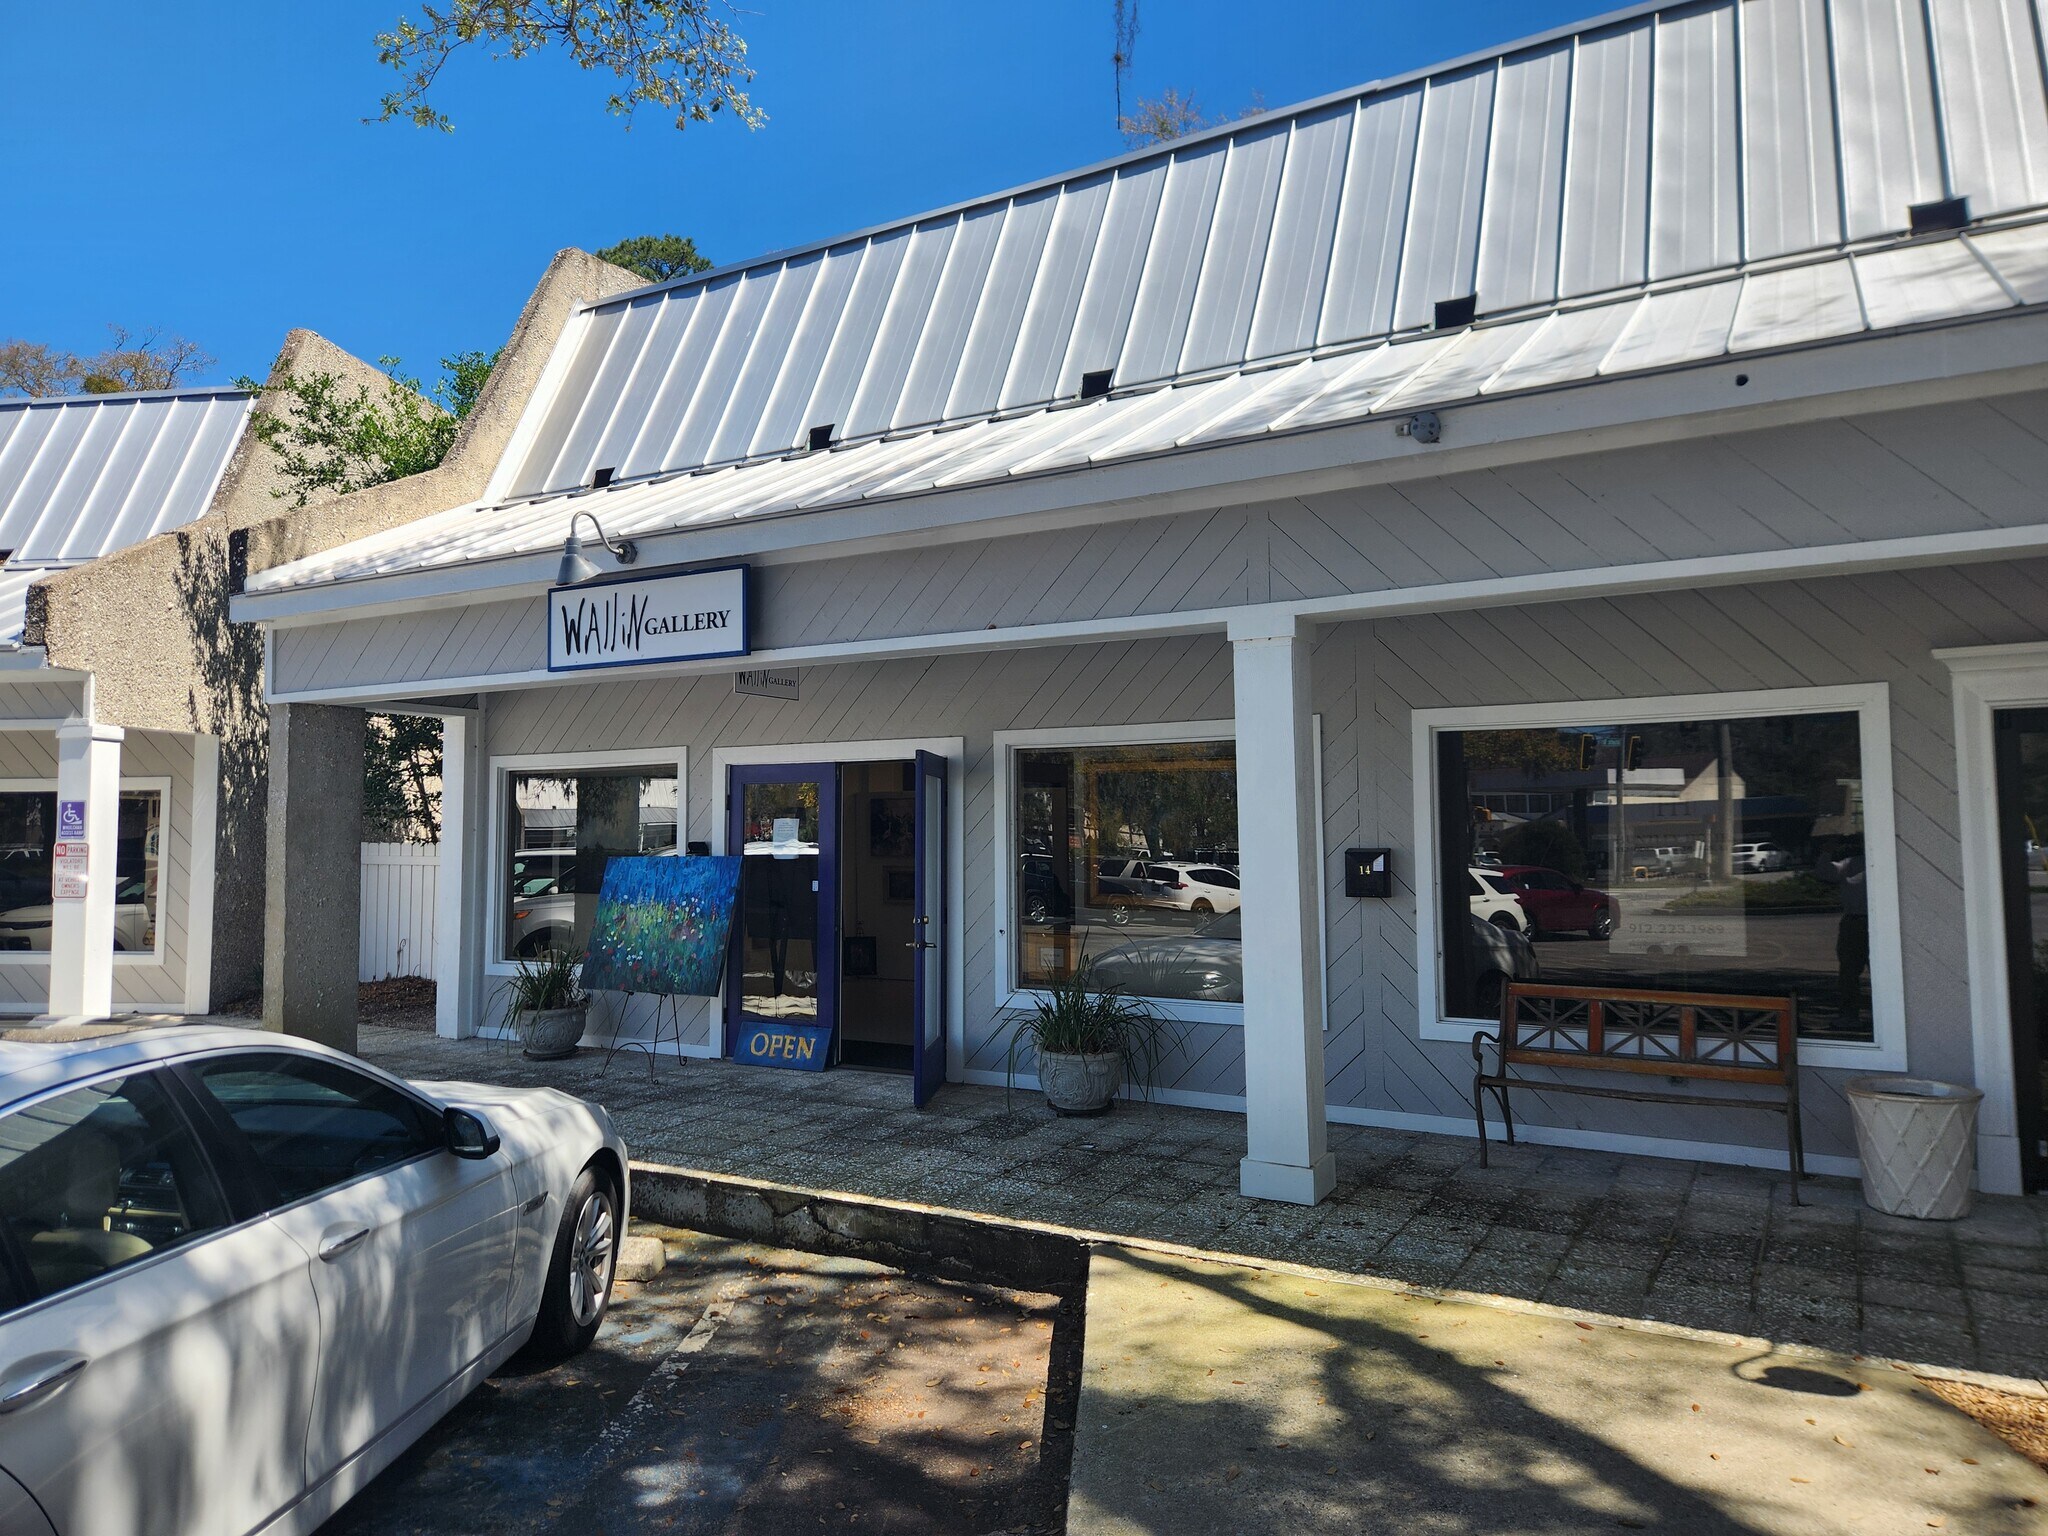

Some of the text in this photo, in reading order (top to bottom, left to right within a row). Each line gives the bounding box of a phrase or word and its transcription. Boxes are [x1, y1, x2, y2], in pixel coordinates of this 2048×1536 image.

[644, 610, 731, 635] GALLERY
[769, 677, 797, 687] GALLERY
[56, 845, 87, 855] NO PARKING
[1359, 865, 1371, 875] 14
[750, 1032, 817, 1059] OPEN
